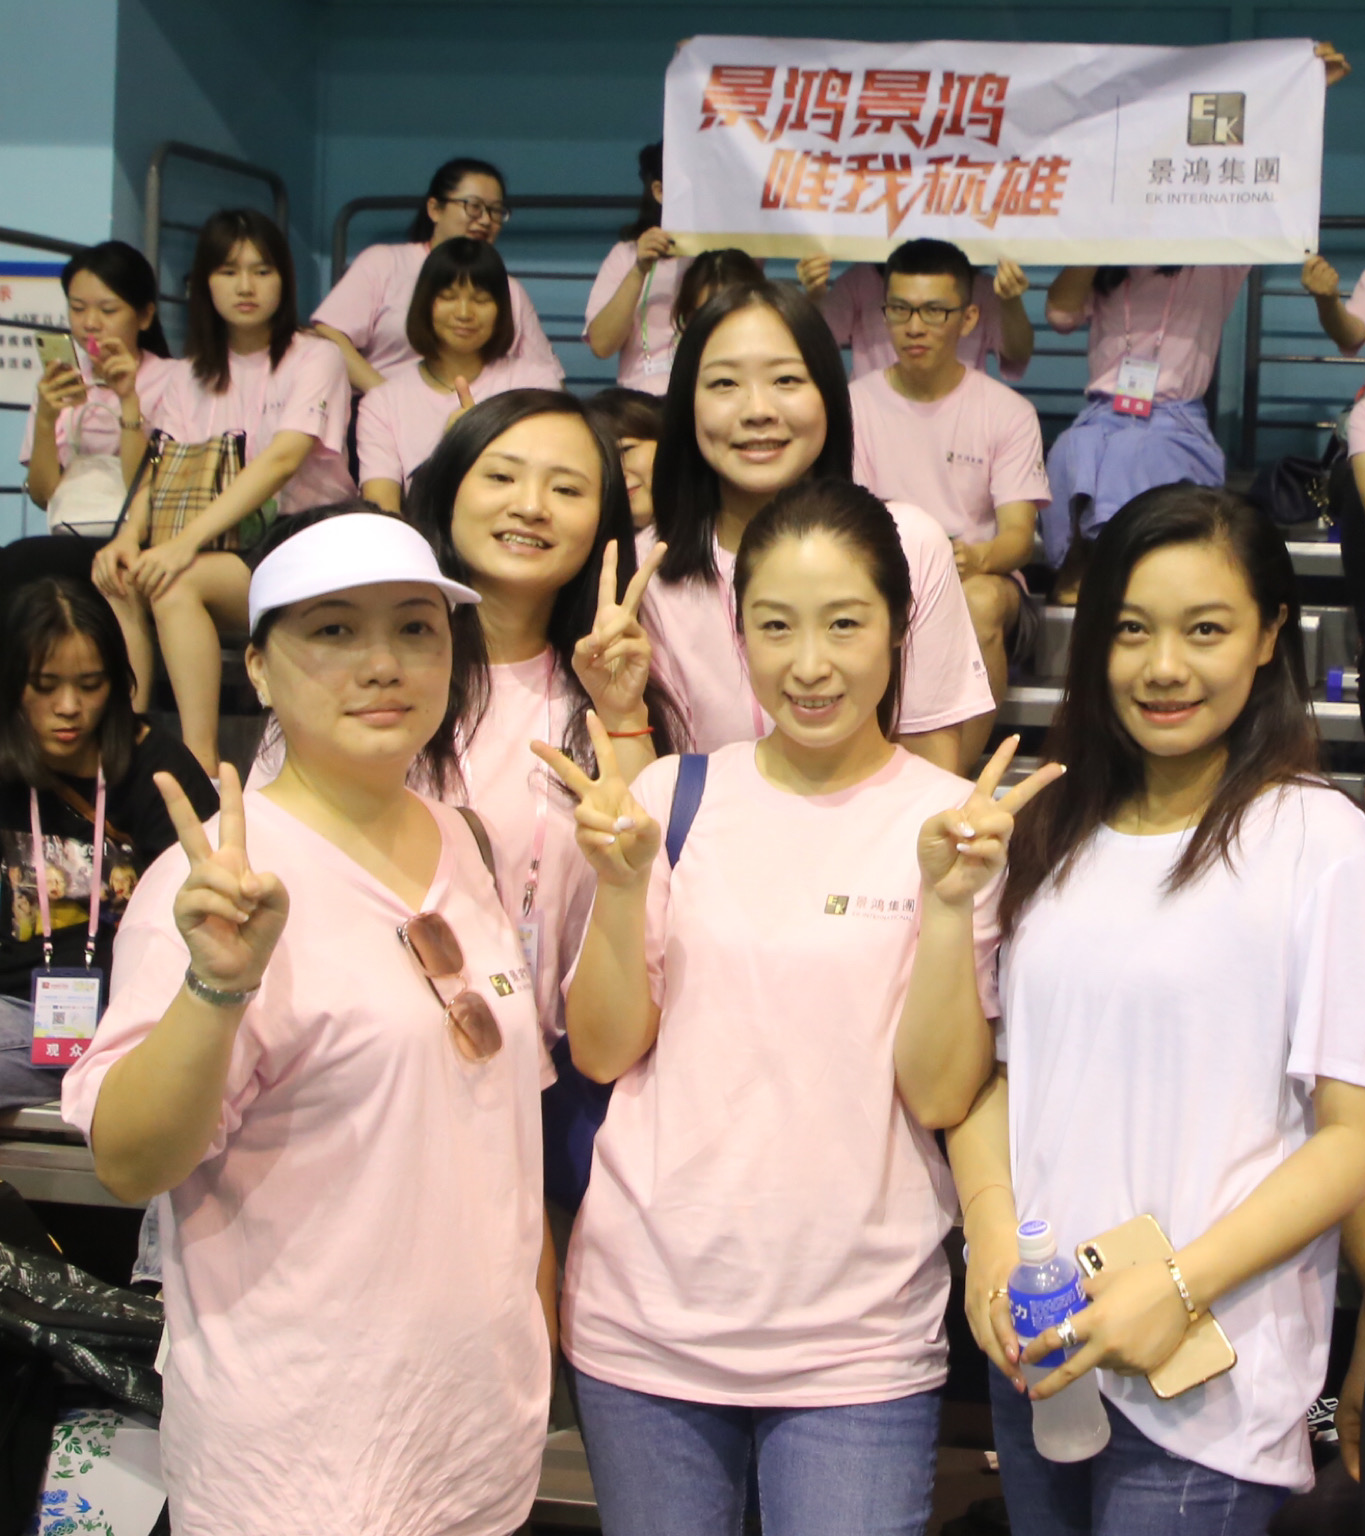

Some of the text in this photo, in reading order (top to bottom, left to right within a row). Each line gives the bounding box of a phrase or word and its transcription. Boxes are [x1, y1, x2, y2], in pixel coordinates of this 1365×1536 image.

[698, 64, 1010, 151] 景鸿景鸿
[760, 148, 1071, 240] 唯我称雄
[1149, 157, 1280, 185] 景鴻集團
[1167, 191, 1275, 204] INTERNATIONAL
